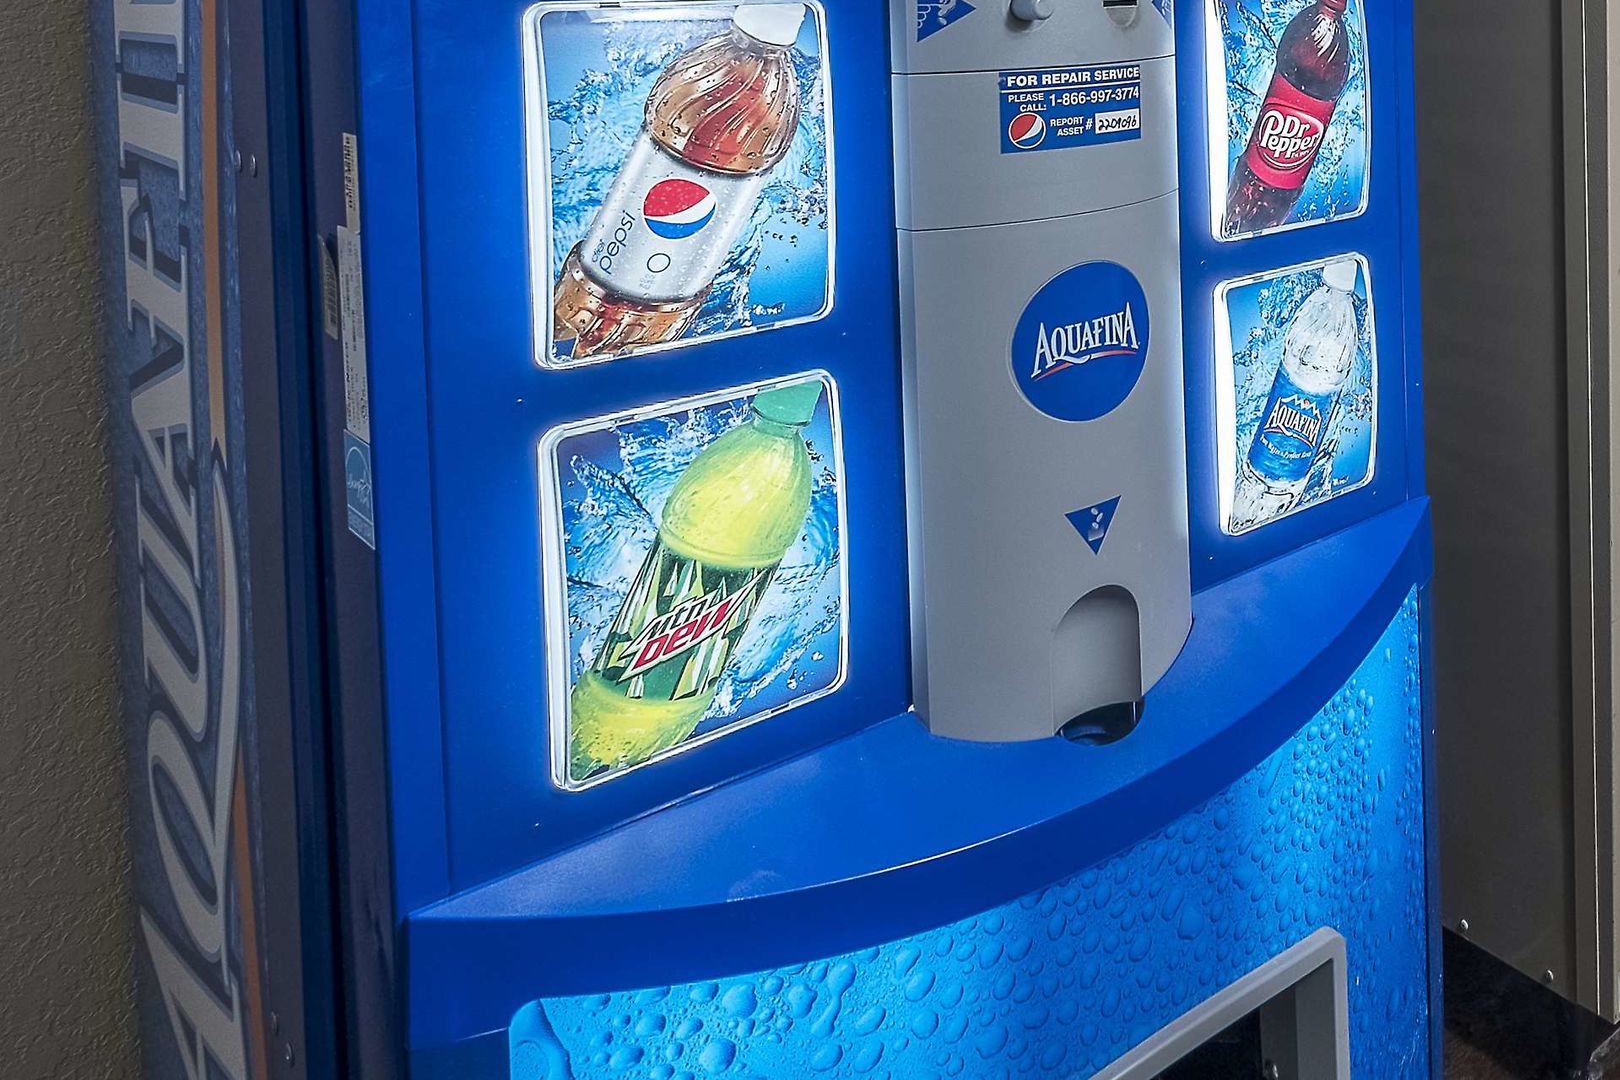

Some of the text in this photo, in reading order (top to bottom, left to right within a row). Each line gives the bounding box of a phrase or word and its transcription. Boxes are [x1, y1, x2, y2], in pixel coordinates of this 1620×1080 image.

[1007, 67, 1140, 87] FOR REPAIR SERVICE
[1008, 93, 1045, 103] PLEASE
[1049, 86, 1140, 107] 1-866-997-3774
[1020, 103, 1047, 112] CALL:
[1050, 116, 1084, 127] REPORT
[1057, 126, 1085, 137] ASSET
[1085, 118, 1093, 131] #
[1281, 115, 1311, 138] Dr
[1259, 110, 1320, 158] Pepper
[600, 209, 636, 275] pepsi
[1031, 301, 1139, 378] AQUAFINA
[1263, 397, 1322, 447] AQUAFINA
